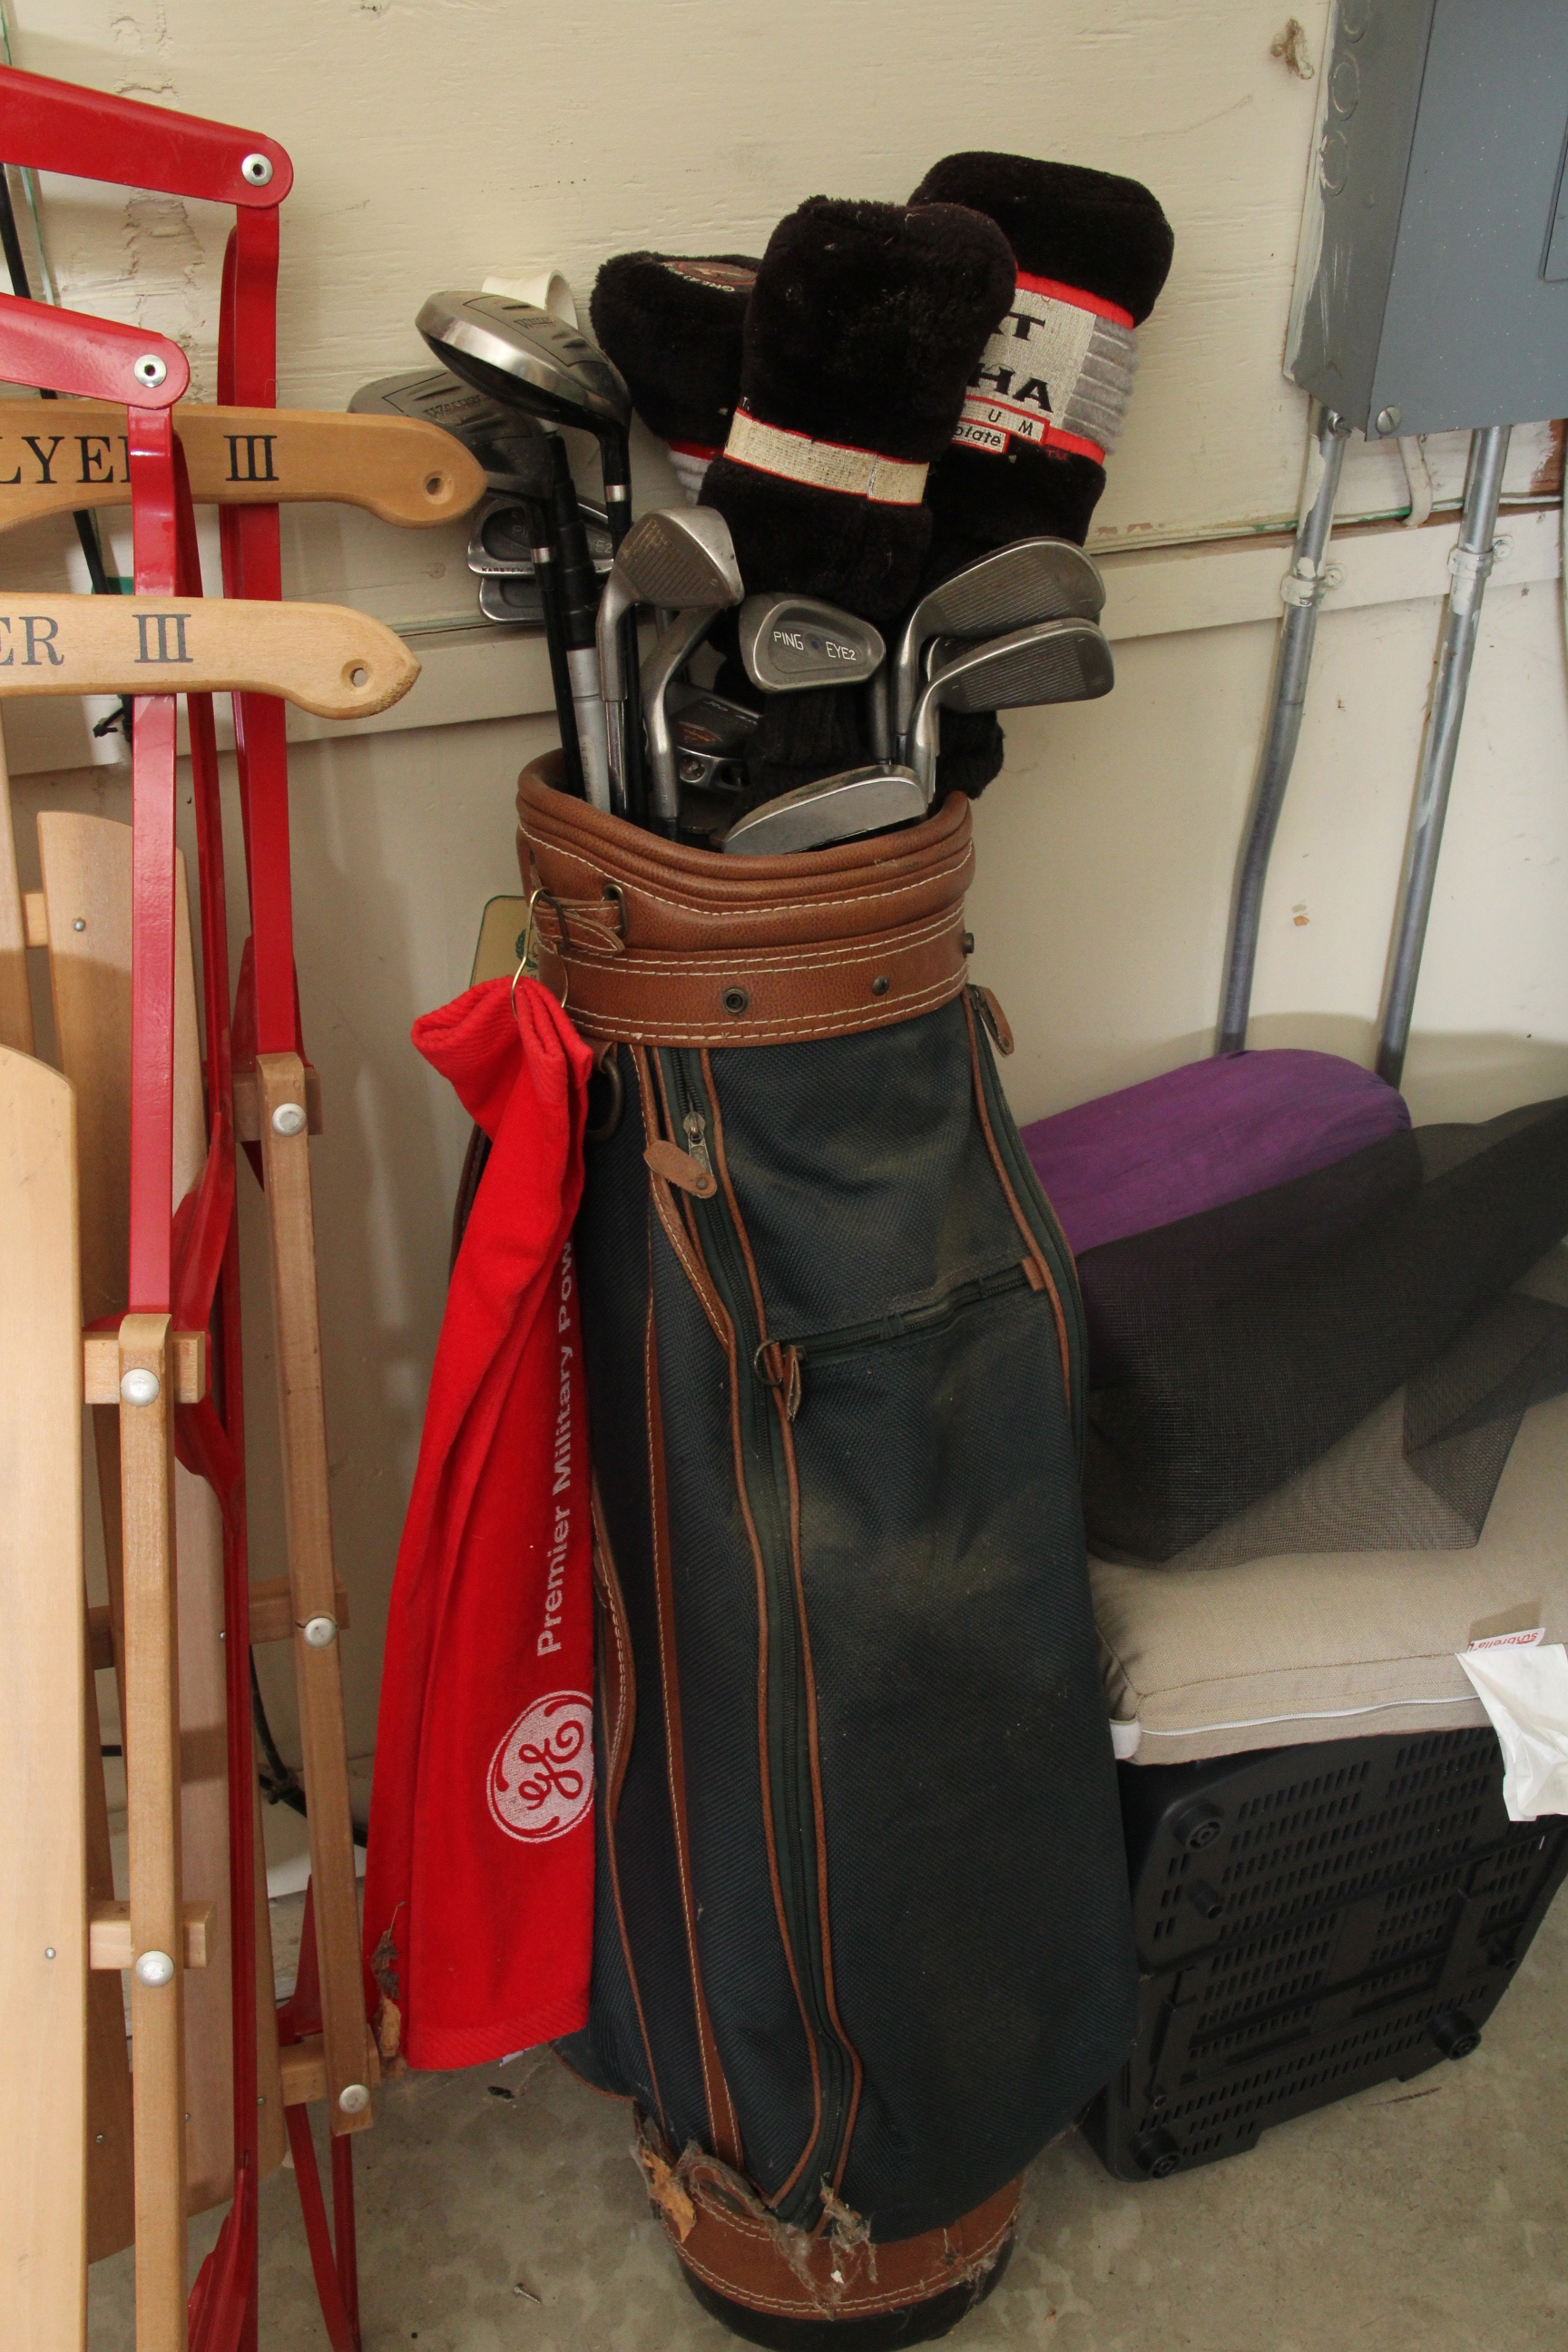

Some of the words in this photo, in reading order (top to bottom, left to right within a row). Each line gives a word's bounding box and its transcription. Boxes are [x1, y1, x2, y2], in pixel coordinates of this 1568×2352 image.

[223, 435, 279, 482] III
[132, 613, 194, 663] III
[773, 631, 804, 652] PING
[825, 641, 858, 661] EYE2
[552, 1346, 574, 1495] Military
[536, 1504, 571, 1657] Premier
[1477, 1632, 1538, 1649] sunbrella
